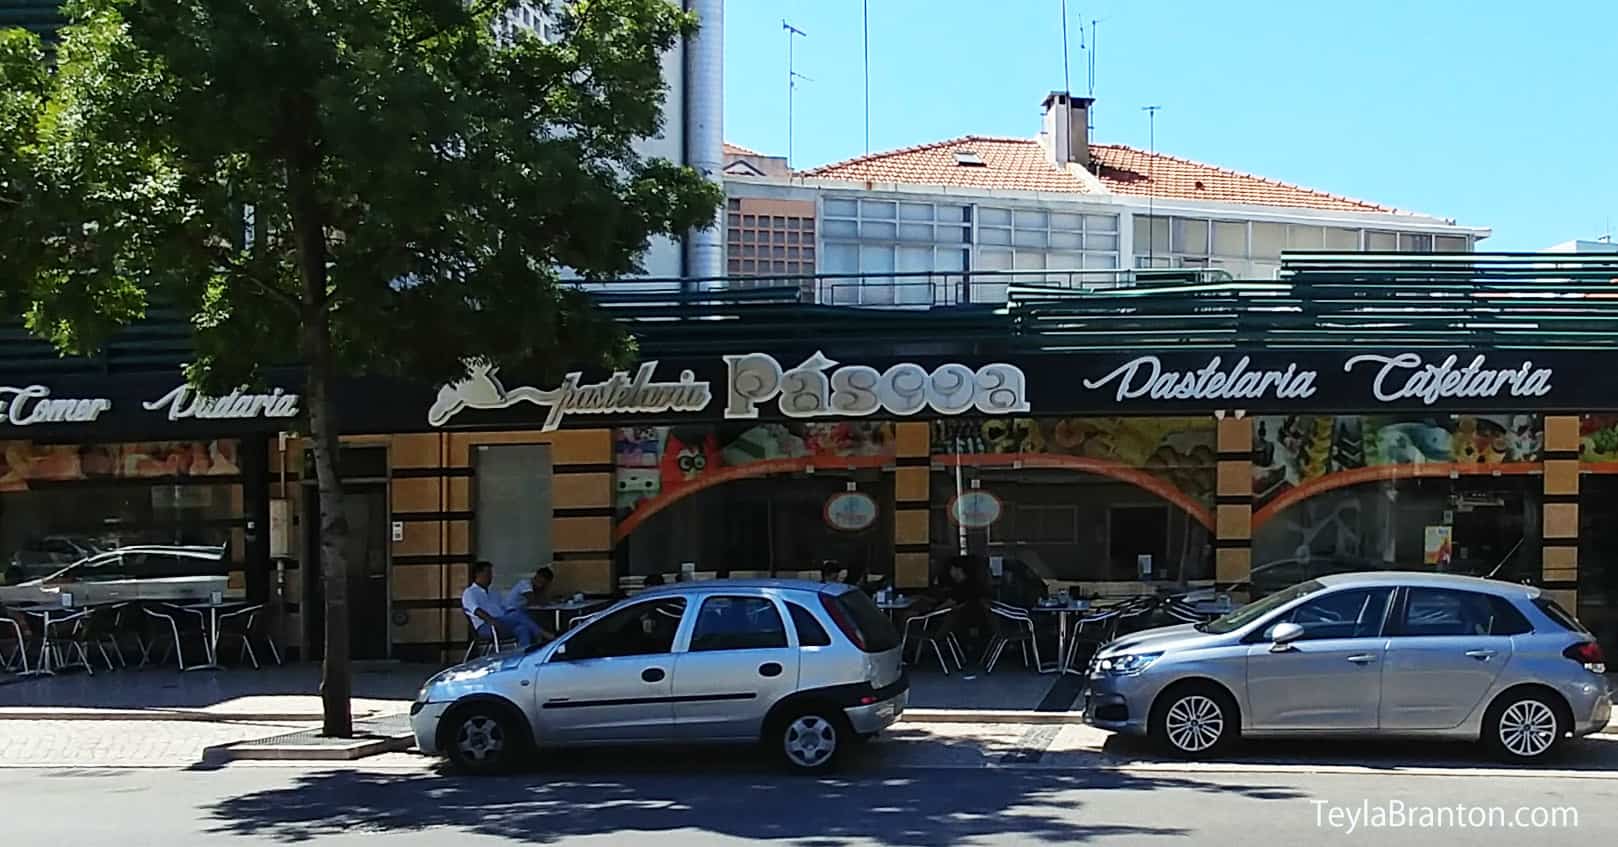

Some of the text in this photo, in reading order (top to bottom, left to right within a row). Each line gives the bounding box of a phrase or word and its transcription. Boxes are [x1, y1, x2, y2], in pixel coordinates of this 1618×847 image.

[722, 350, 1031, 419] Páscoa
[1083, 356, 1317, 402] Pastelaria
[1344, 354, 1553, 404] Cafetaria
[0, 384, 112, 426] Comer
